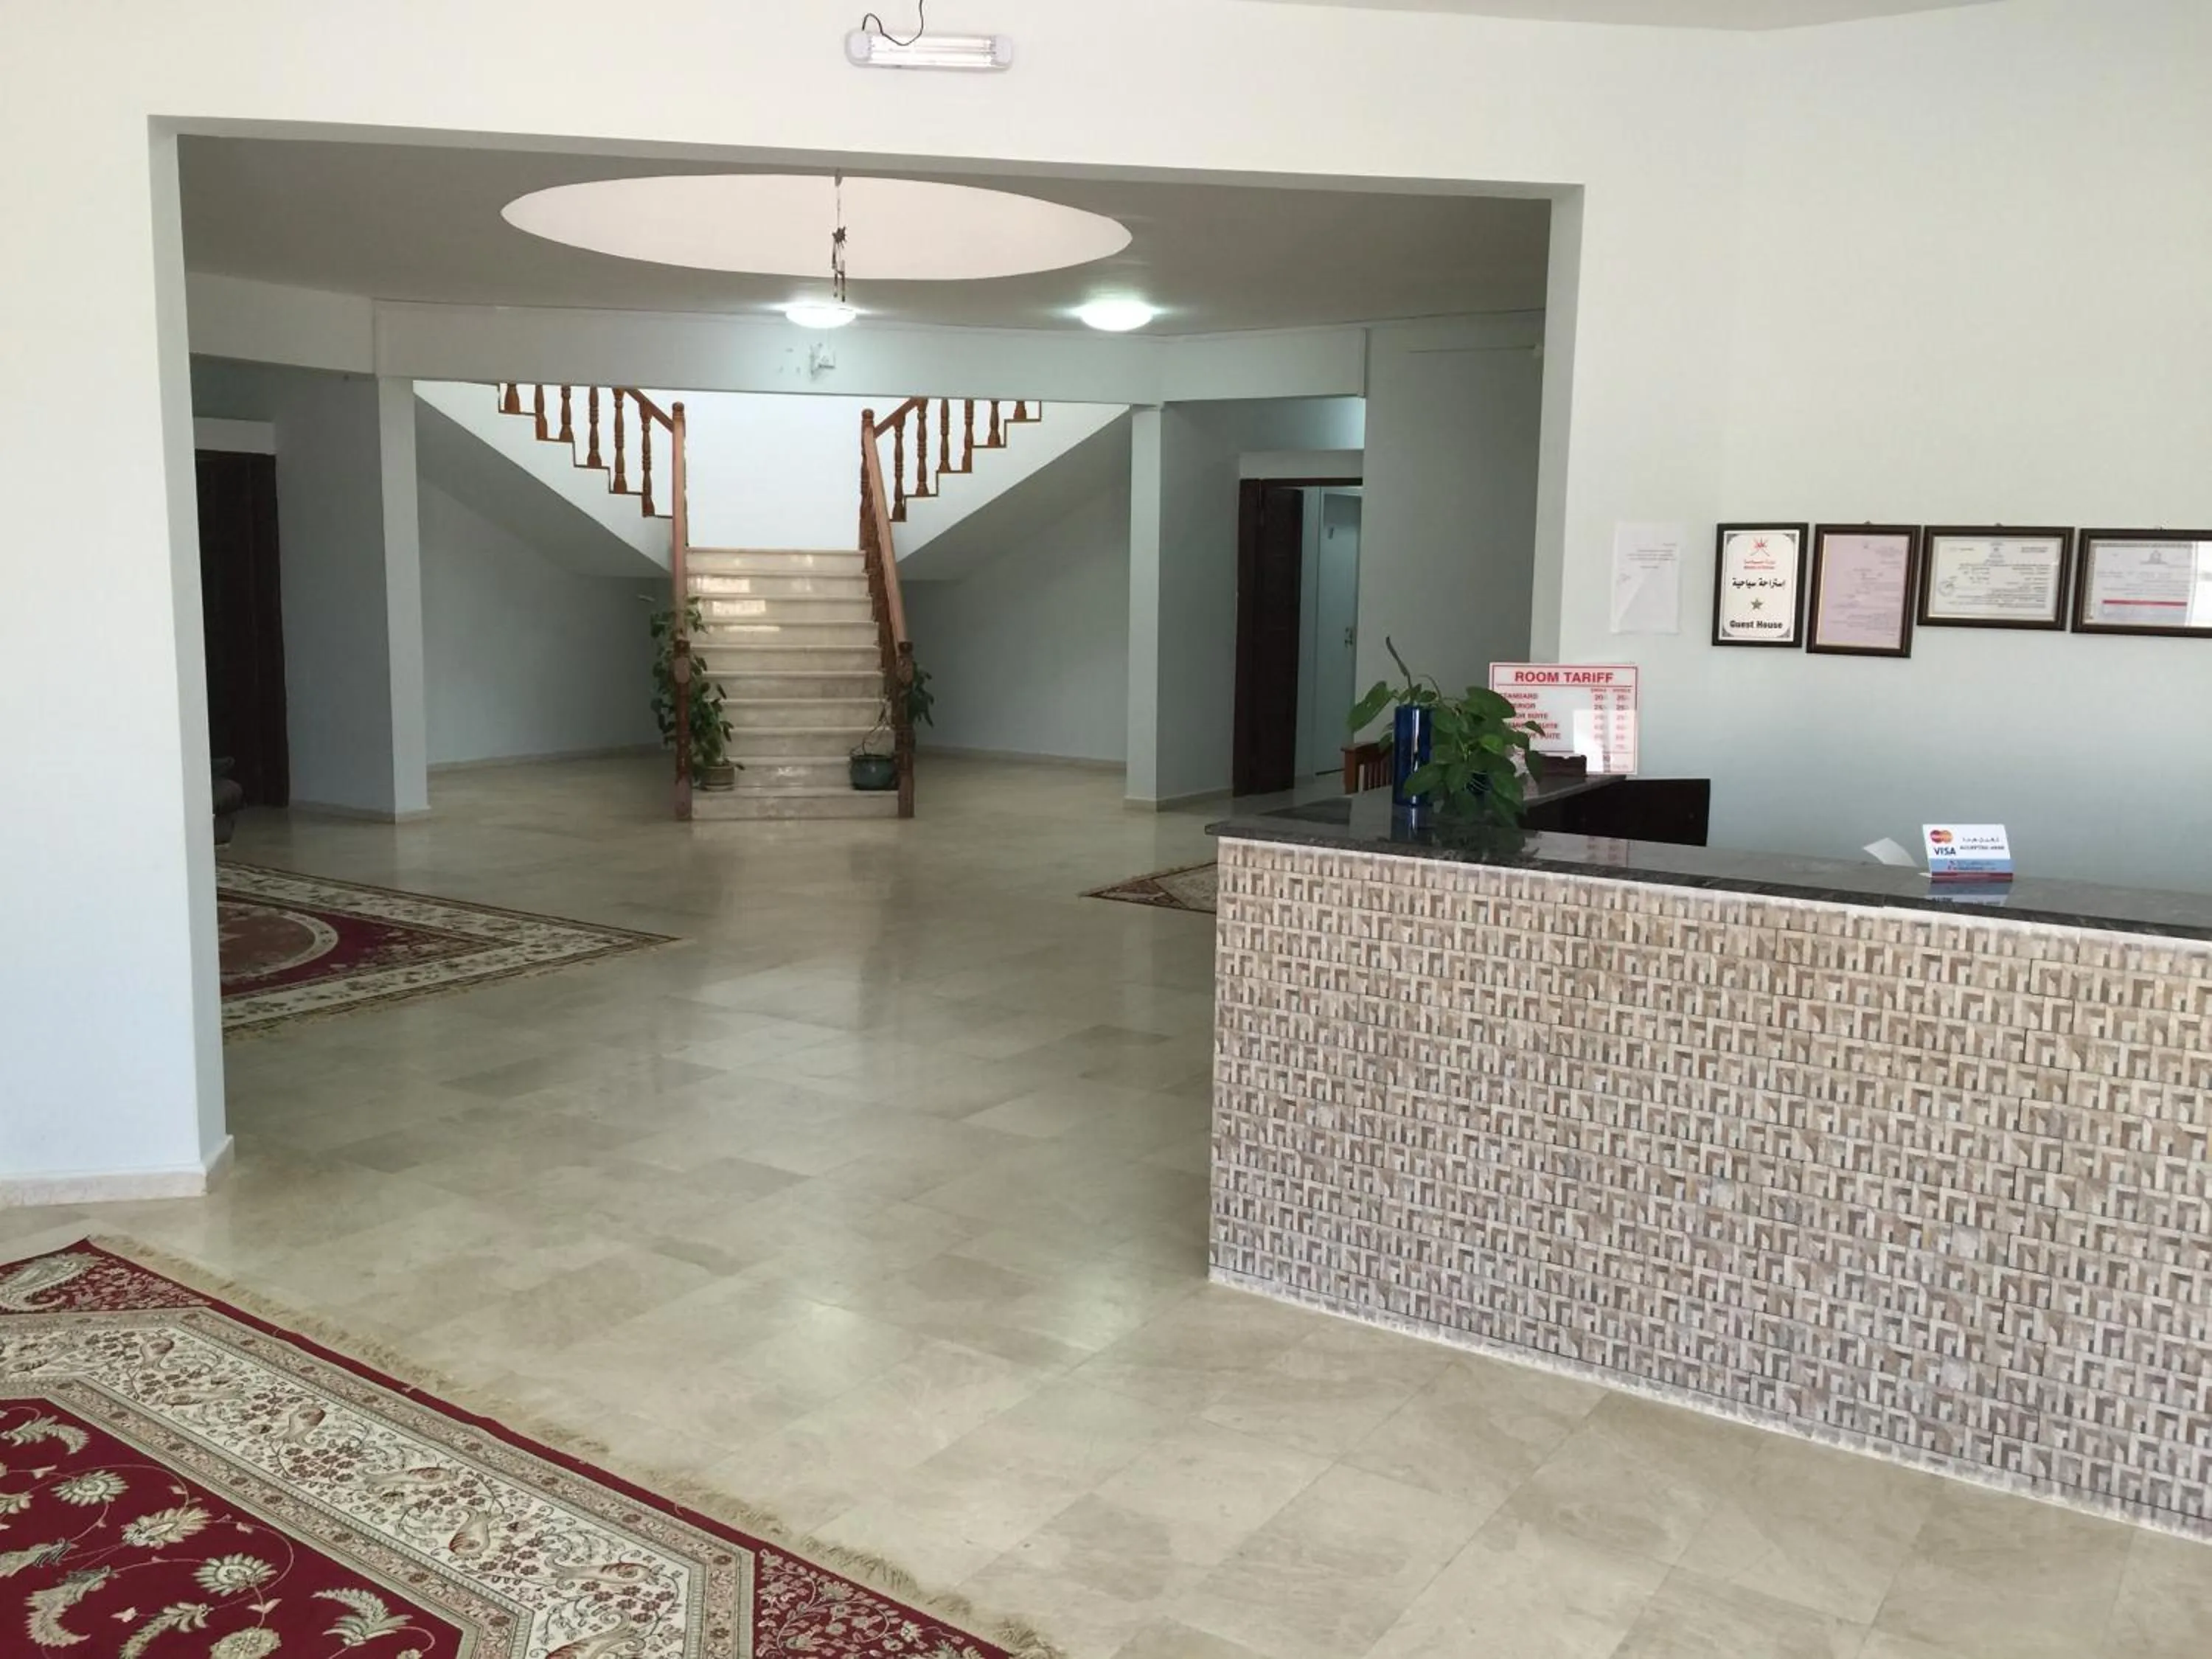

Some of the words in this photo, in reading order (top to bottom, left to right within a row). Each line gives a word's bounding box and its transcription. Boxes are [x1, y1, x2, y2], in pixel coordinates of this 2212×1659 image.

[1730, 620, 1754, 628] Guest
[1756, 621, 1783, 629] House
[1514, 672, 1559, 682] ROOM
[1564, 672, 1614, 683] TARIFF
[1934, 847, 1956, 855] VISA
